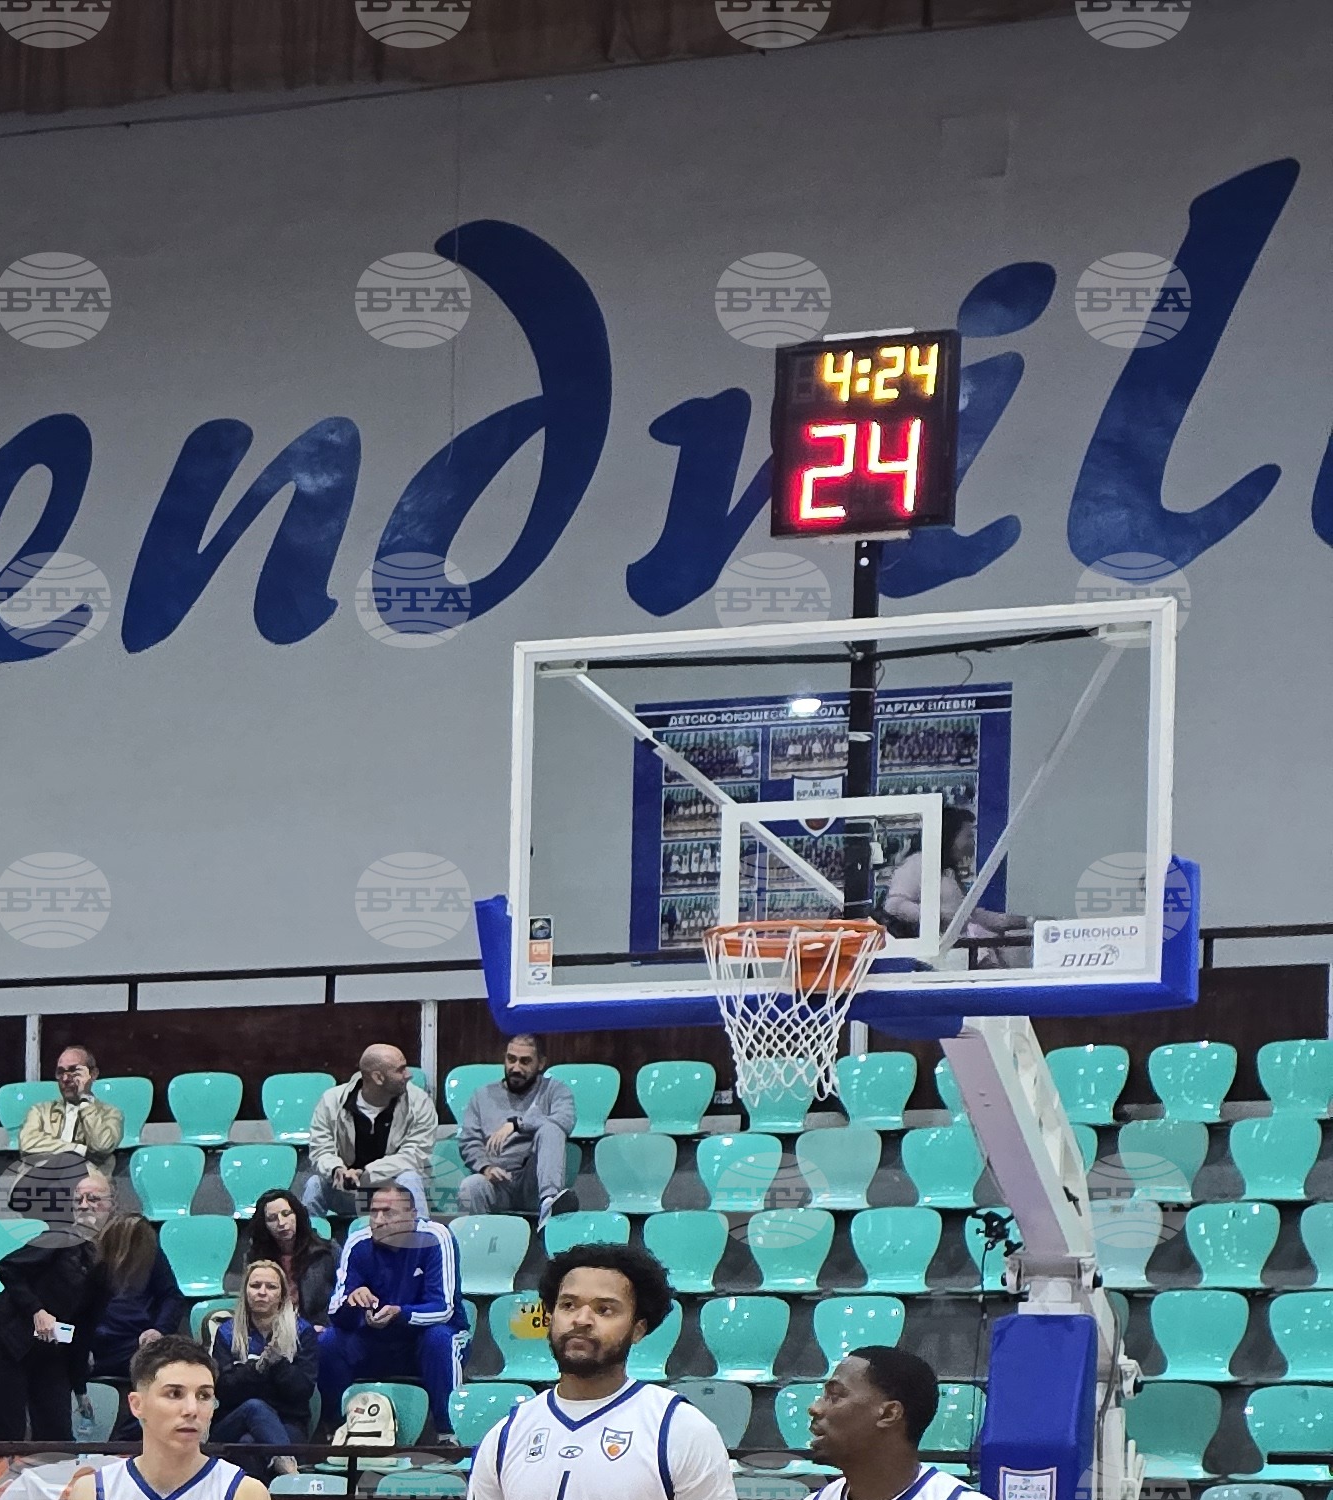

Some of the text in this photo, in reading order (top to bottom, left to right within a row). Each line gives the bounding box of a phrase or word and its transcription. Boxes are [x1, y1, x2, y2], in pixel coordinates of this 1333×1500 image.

[823, 342, 939, 403] 4:24
[799, 417, 923, 520] 24
[1063, 925, 1139, 940] EUROHOLD
